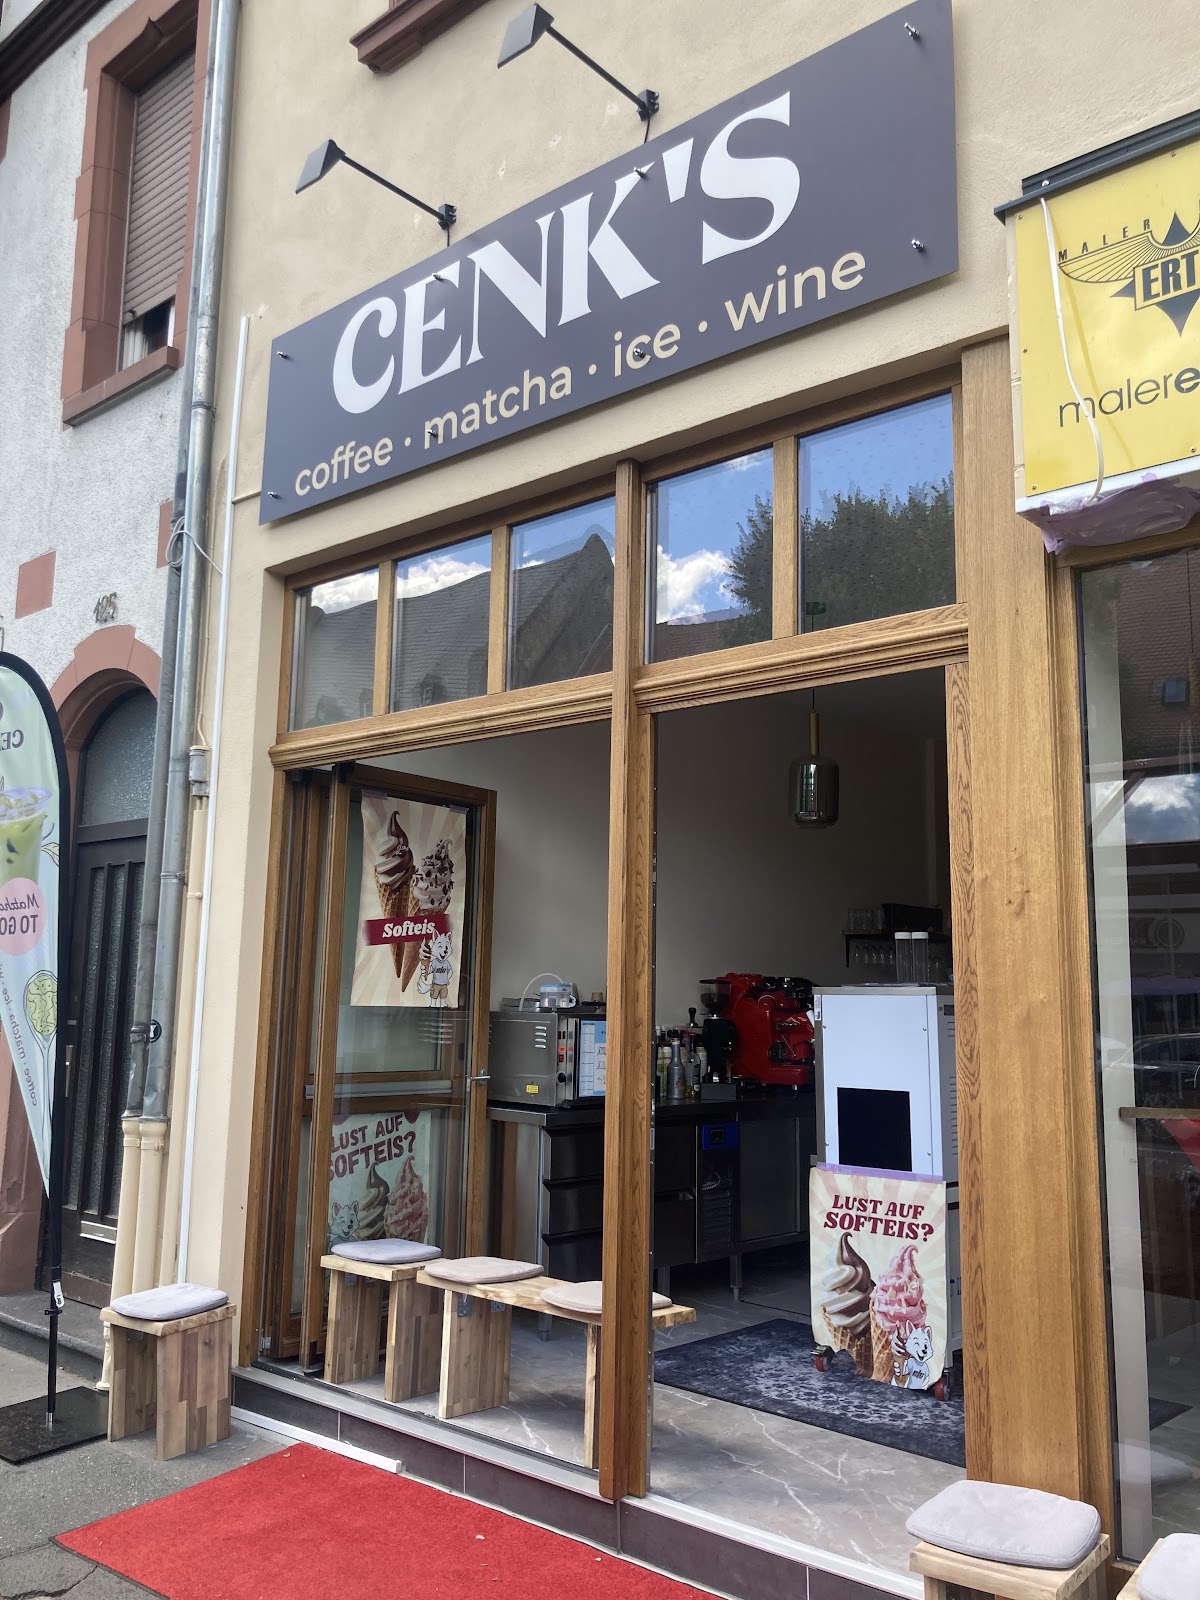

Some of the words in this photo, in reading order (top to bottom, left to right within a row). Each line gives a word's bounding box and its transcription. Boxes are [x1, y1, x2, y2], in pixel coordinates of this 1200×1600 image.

[332, 91, 800, 414] CENK'S
[1058, 218, 1151, 263] MALER
[1142, 249, 1200, 303] ERT
[295, 436, 393, 497] coffee
[424, 361, 573, 449] matcha
[613, 323, 681, 378] ice
[724, 251, 866, 332] wine
[1059, 367, 1200, 428] malere
[382, 918, 436, 939] Softeis
[332, 1125, 368, 1153] LUST
[375, 1114, 403, 1139] AUF
[823, 1211, 934, 1242] SOFTEIS?
[832, 1194, 883, 1214] LUST
[885, 1201, 925, 1220] AUF
